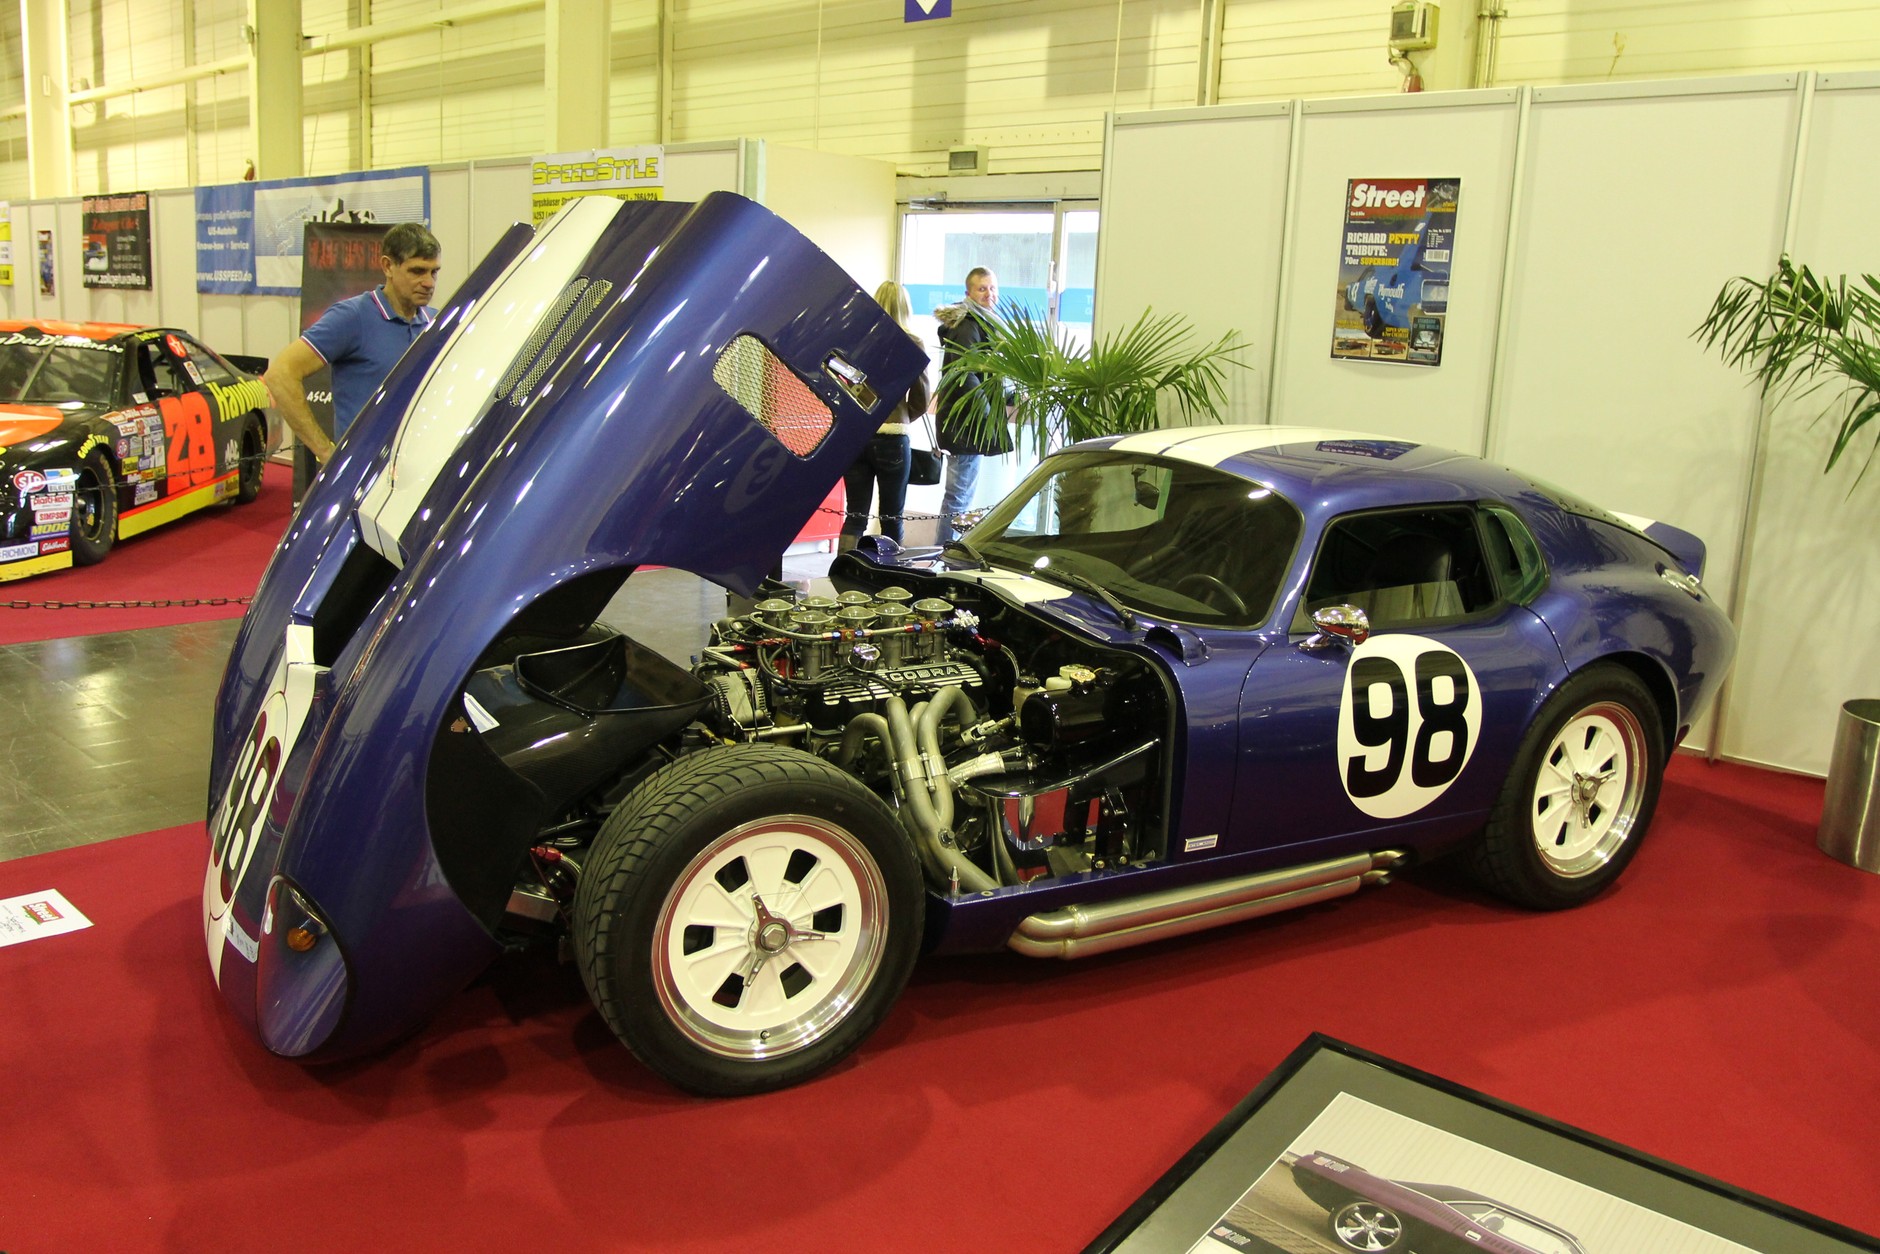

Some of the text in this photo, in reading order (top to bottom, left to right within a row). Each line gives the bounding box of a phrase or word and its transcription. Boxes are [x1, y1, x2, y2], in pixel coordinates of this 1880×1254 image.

[1352, 183, 1426, 208] Street
[1347, 232, 1387, 244] RICHARD
[1388, 233, 1420, 244] PETTY
[1346, 245, 1388, 256] TRIBUTE:
[1360, 257, 1400, 267] SUPERBIRD!
[1377, 283, 1405, 300] Plymouth
[77, 433, 109, 459] GOODYEAR
[159, 391, 215, 495] 28
[18, 473, 43, 488] STP
[48, 484, 75, 492] BILSTEIN
[39, 511, 68, 521] SIMPSON
[31, 524, 70, 535] MOOG
[2, 545, 37, 559] RICHMOND
[889, 665, 959, 682] COBRA
[1347, 650, 1470, 798] 98
[213, 710, 282, 904] 98
